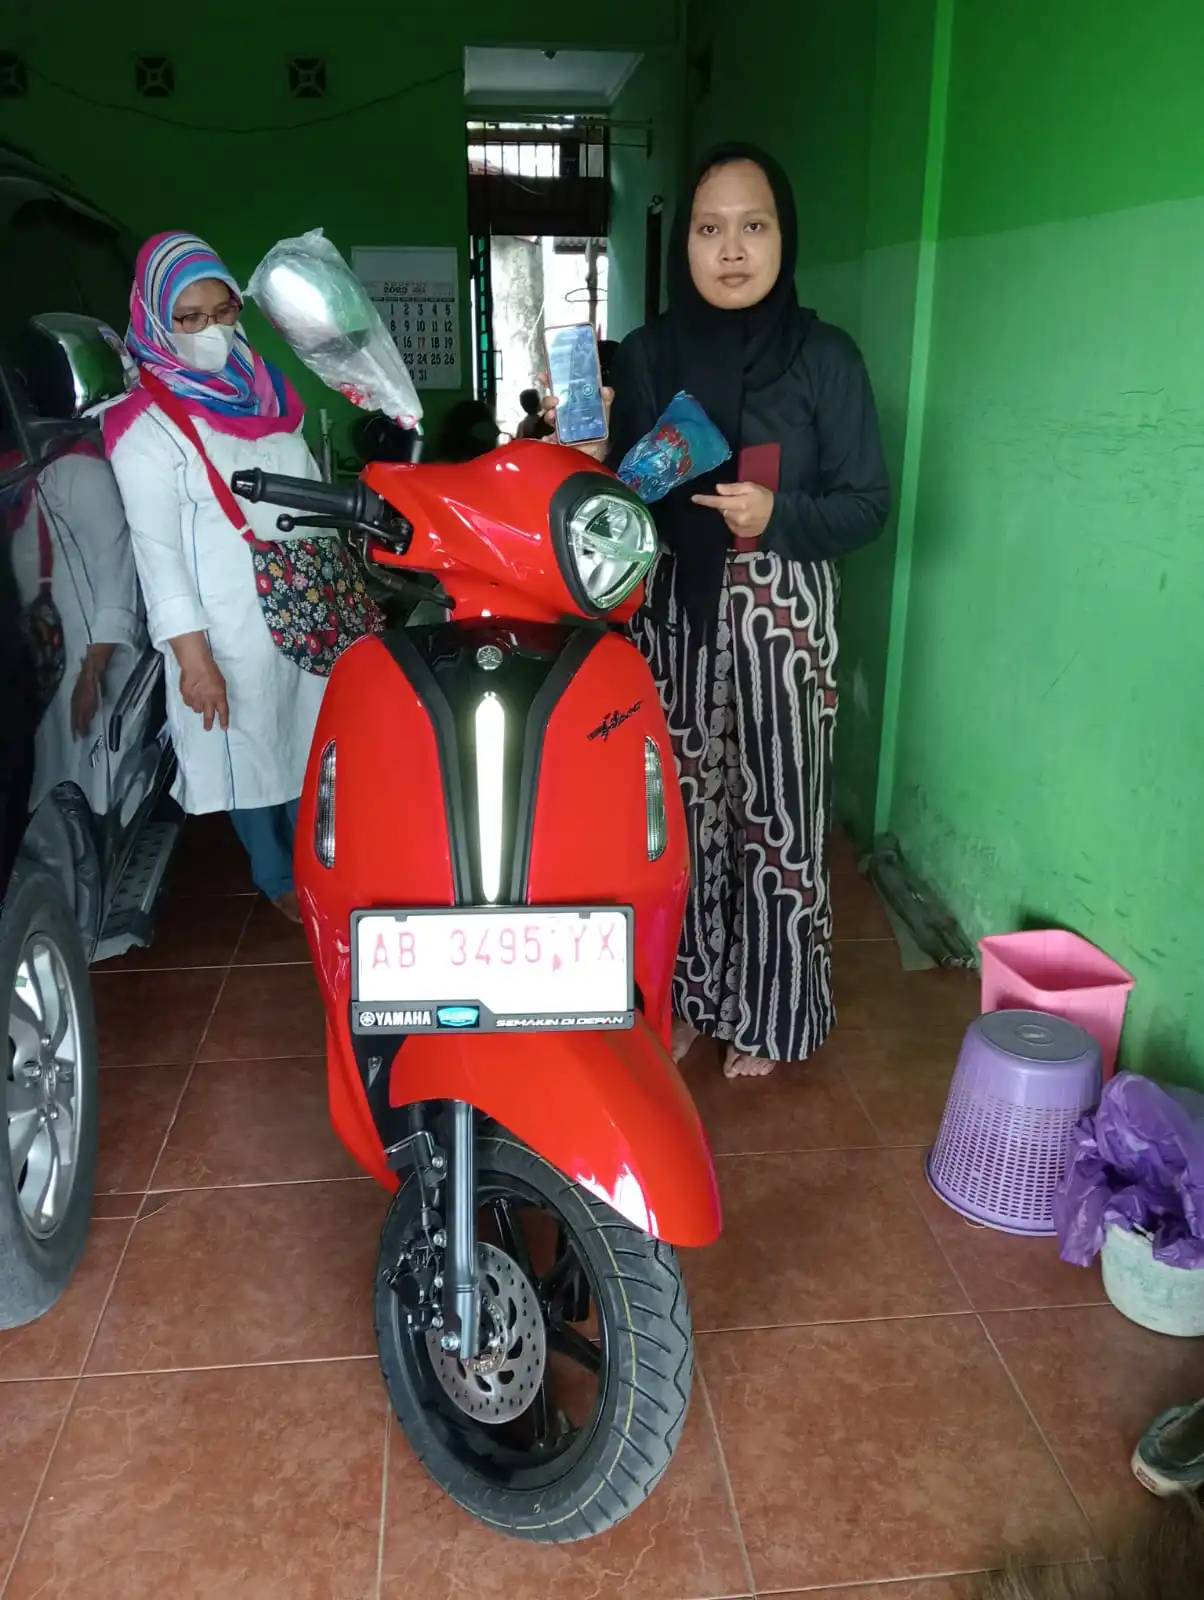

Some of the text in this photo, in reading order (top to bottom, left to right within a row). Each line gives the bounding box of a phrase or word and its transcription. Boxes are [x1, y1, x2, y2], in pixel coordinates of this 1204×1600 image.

[384, 286, 408, 294] 2023
[390, 303, 451, 316] 1 2 3 4 5
[390, 319, 453, 332] 8 9 10 11 12
[403, 336, 412, 349] 16
[417, 336, 426, 349] 17
[431, 336, 440, 349] 18
[444, 336, 453, 349] 19
[403, 353, 455, 365] 23 24 25 26
[418, 369, 428, 381] 31
[372, 931, 416, 969] AB
[449, 925, 542, 966] 3495
[375, 1011, 431, 1026] YAMAHA
[495, 1018, 559, 1027] SEMAKIN
[576, 1016, 624, 1025] DEPAN
